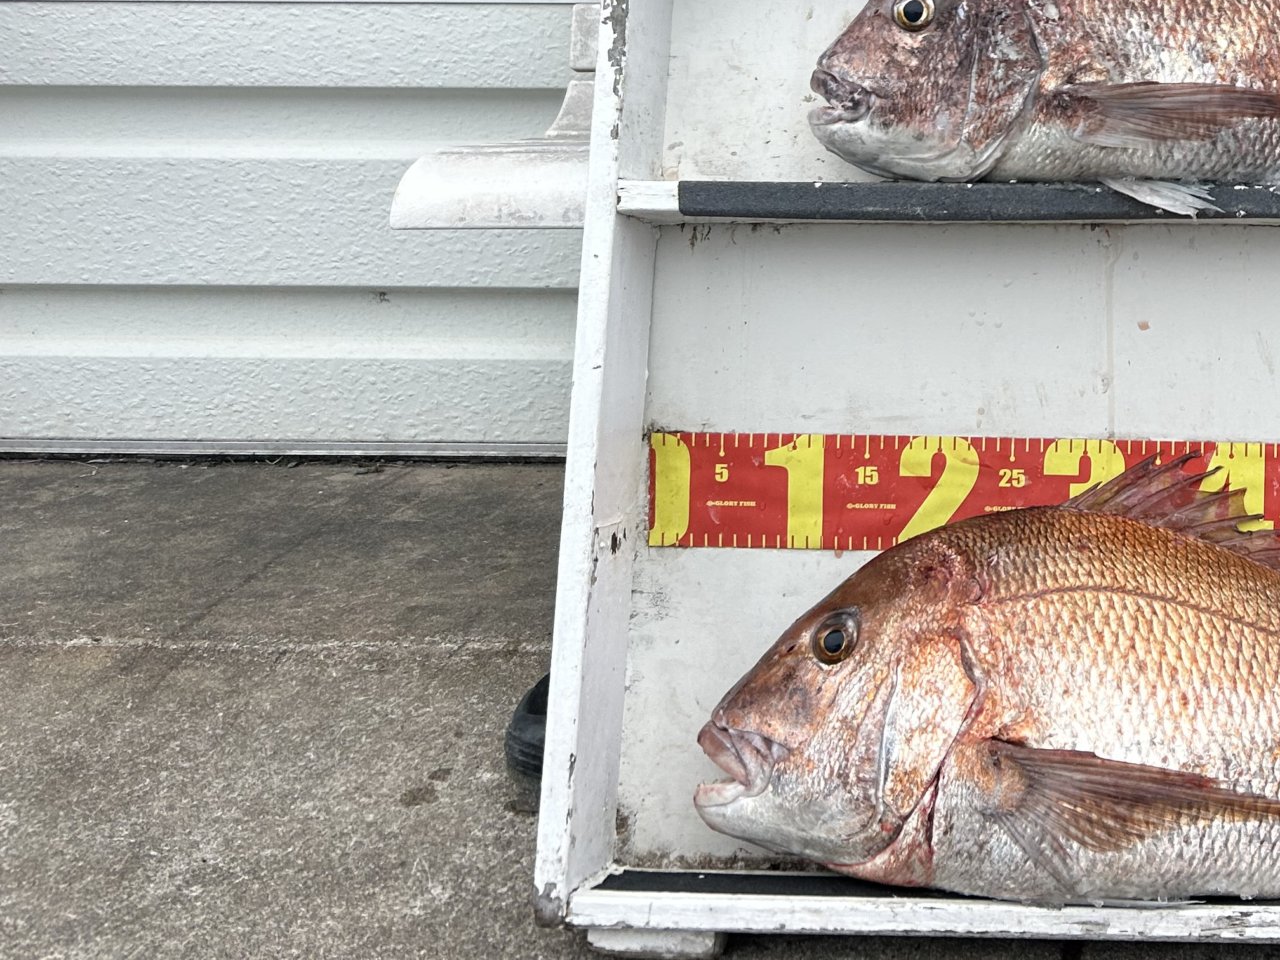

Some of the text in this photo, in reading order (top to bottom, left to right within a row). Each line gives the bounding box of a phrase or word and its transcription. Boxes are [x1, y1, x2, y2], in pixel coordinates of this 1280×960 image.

[714, 464, 729, 482] 5
[765, 433, 824, 549] 1
[855, 466, 879, 485] 15
[898, 435, 980, 545] 2
[998, 468, 1026, 488] 25
